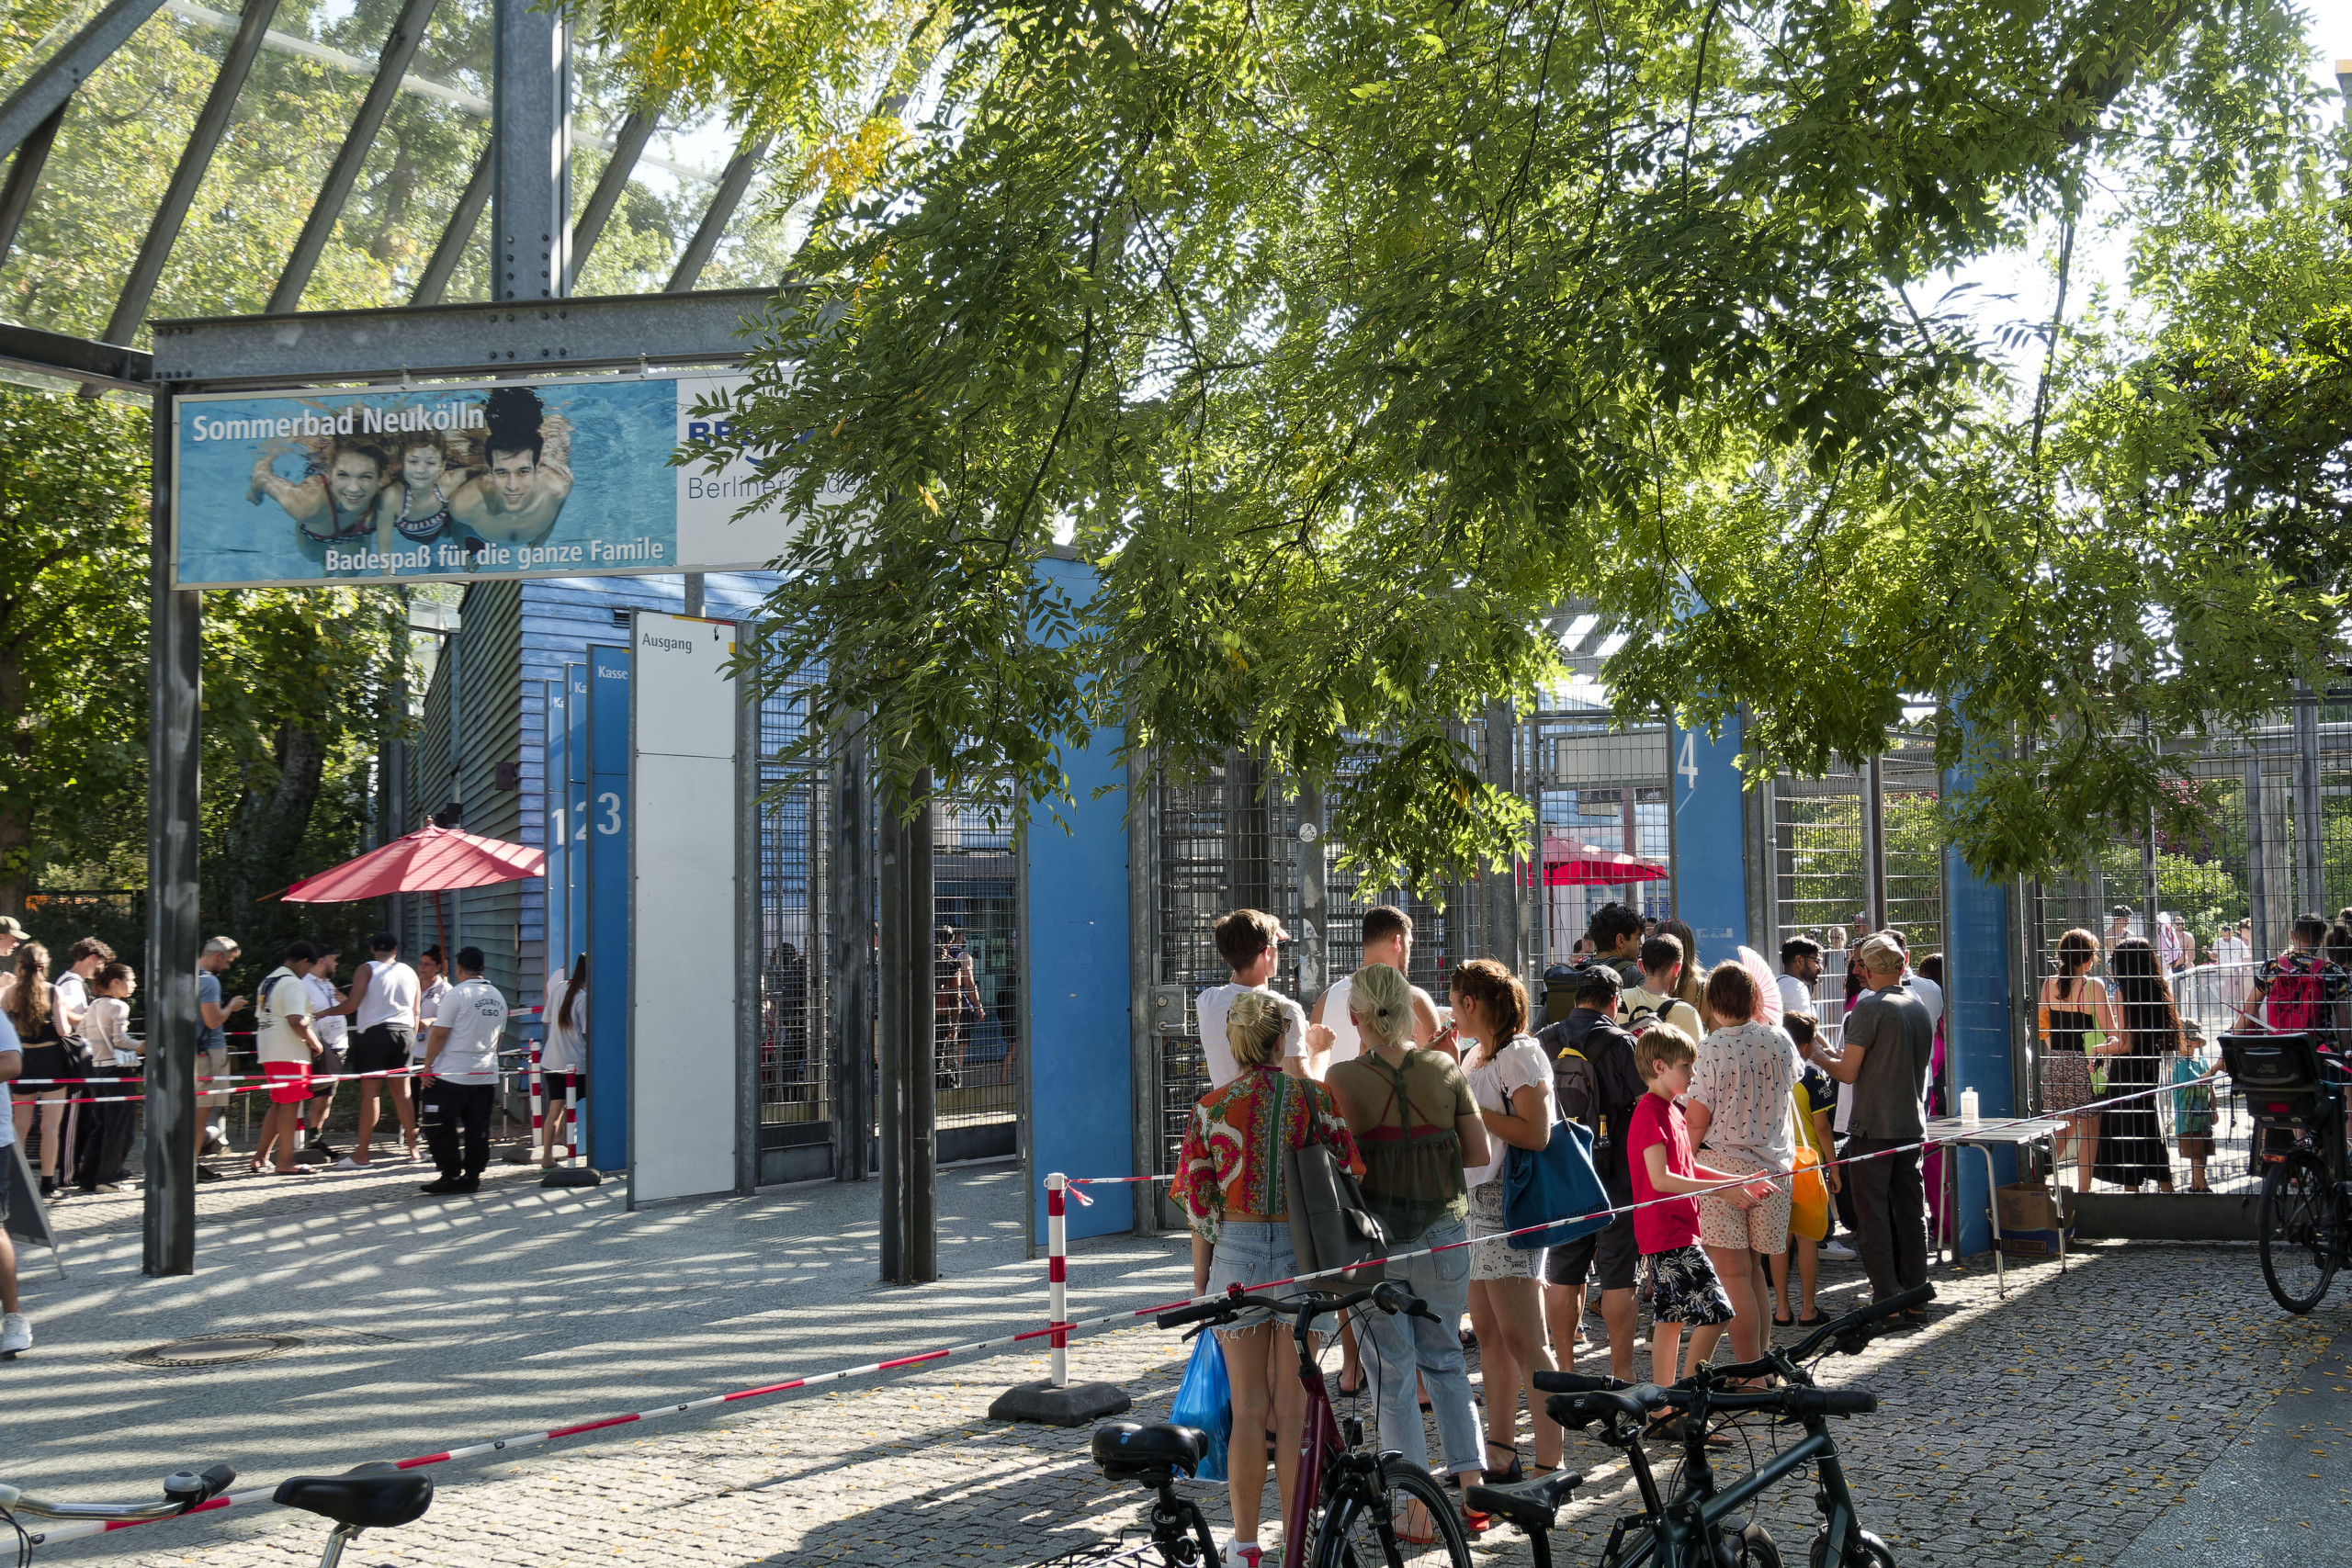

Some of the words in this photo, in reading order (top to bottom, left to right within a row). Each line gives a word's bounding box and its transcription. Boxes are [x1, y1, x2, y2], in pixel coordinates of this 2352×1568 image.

[193, 407, 354, 442] Sommerbad
[362, 401, 485, 434] Neukölln
[689, 475, 786, 499] Berliner
[325, 544, 432, 575] Badespaß
[437, 544, 470, 568] für
[477, 542, 511, 566] die
[517, 545, 583, 570] ganze
[590, 536, 664, 562] Famile
[642, 633, 693, 653] Ausgang
[597, 665, 629, 680] Kasse
[1677, 733, 1699, 789] 4
[551, 808, 565, 845] 1
[596, 792, 622, 835] 3
